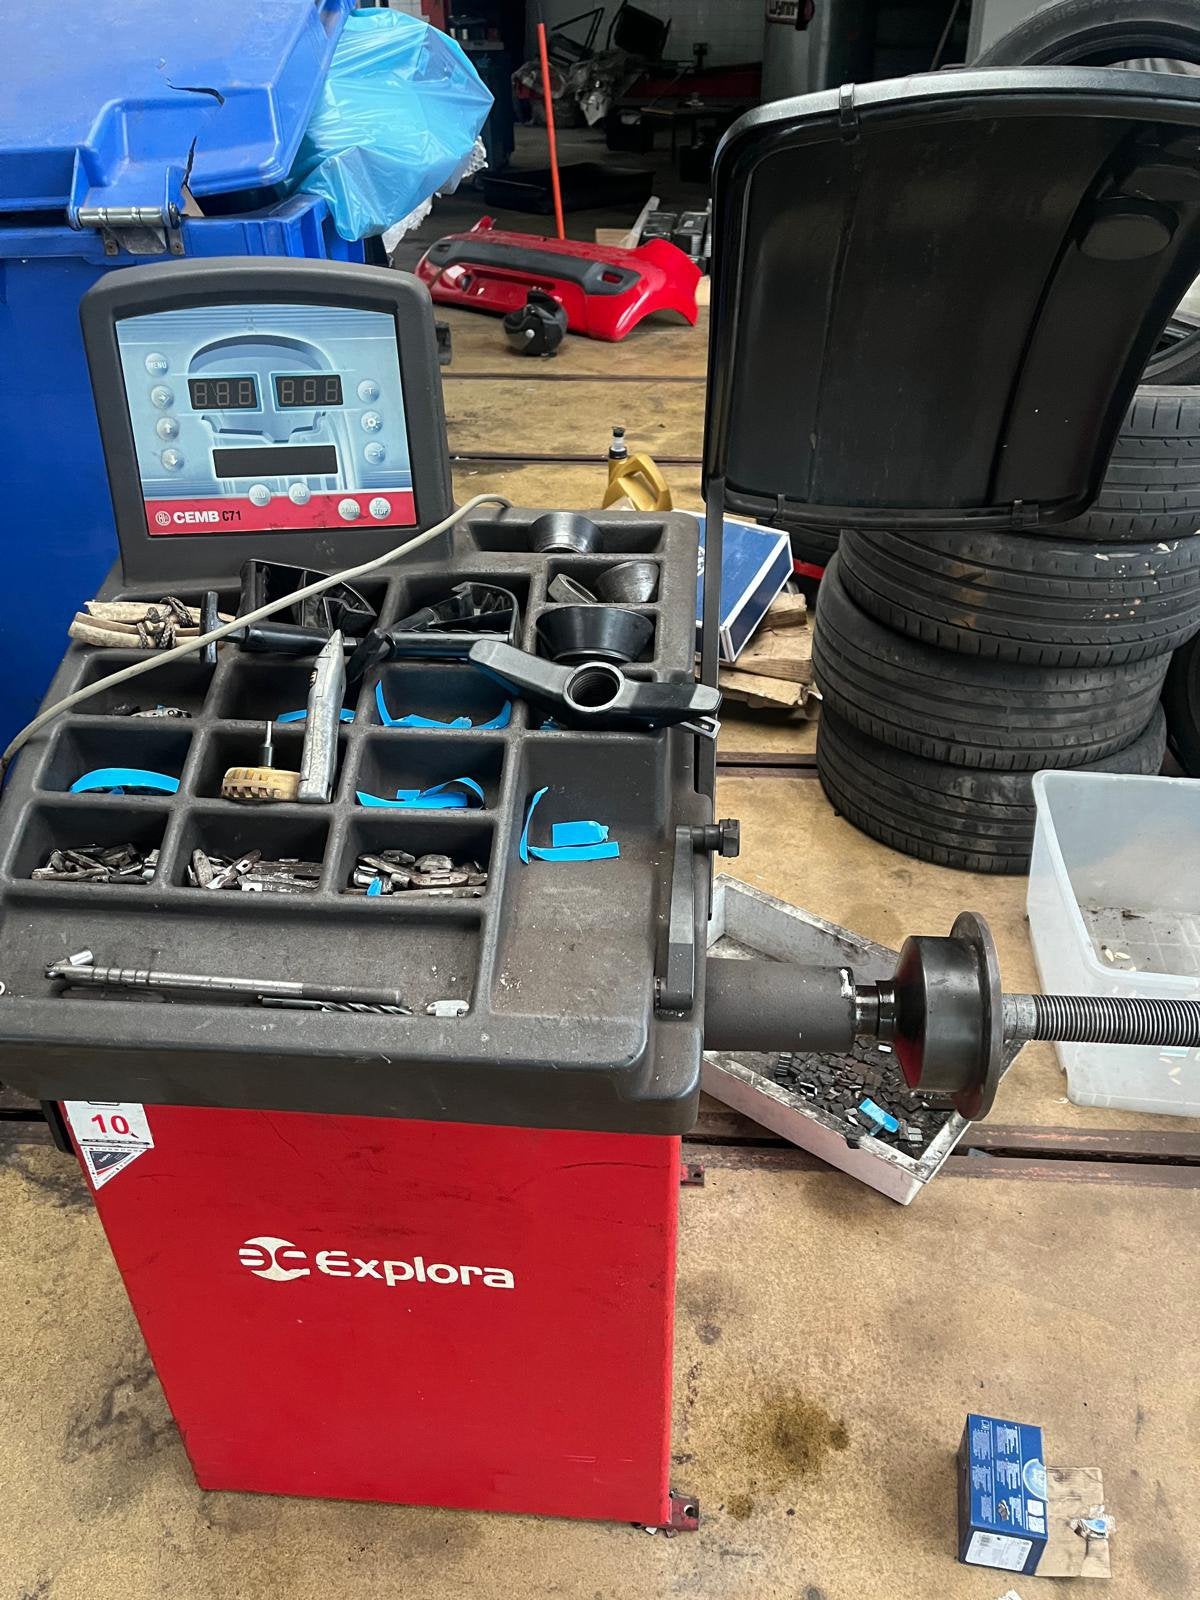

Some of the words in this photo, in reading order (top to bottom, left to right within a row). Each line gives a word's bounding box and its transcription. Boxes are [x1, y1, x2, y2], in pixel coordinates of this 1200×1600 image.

[173, 510, 220, 524] CEMB
[222, 510, 242, 521] C71
[91, 1114, 130, 1135] 10
[315, 1250, 515, 1289] Explora
